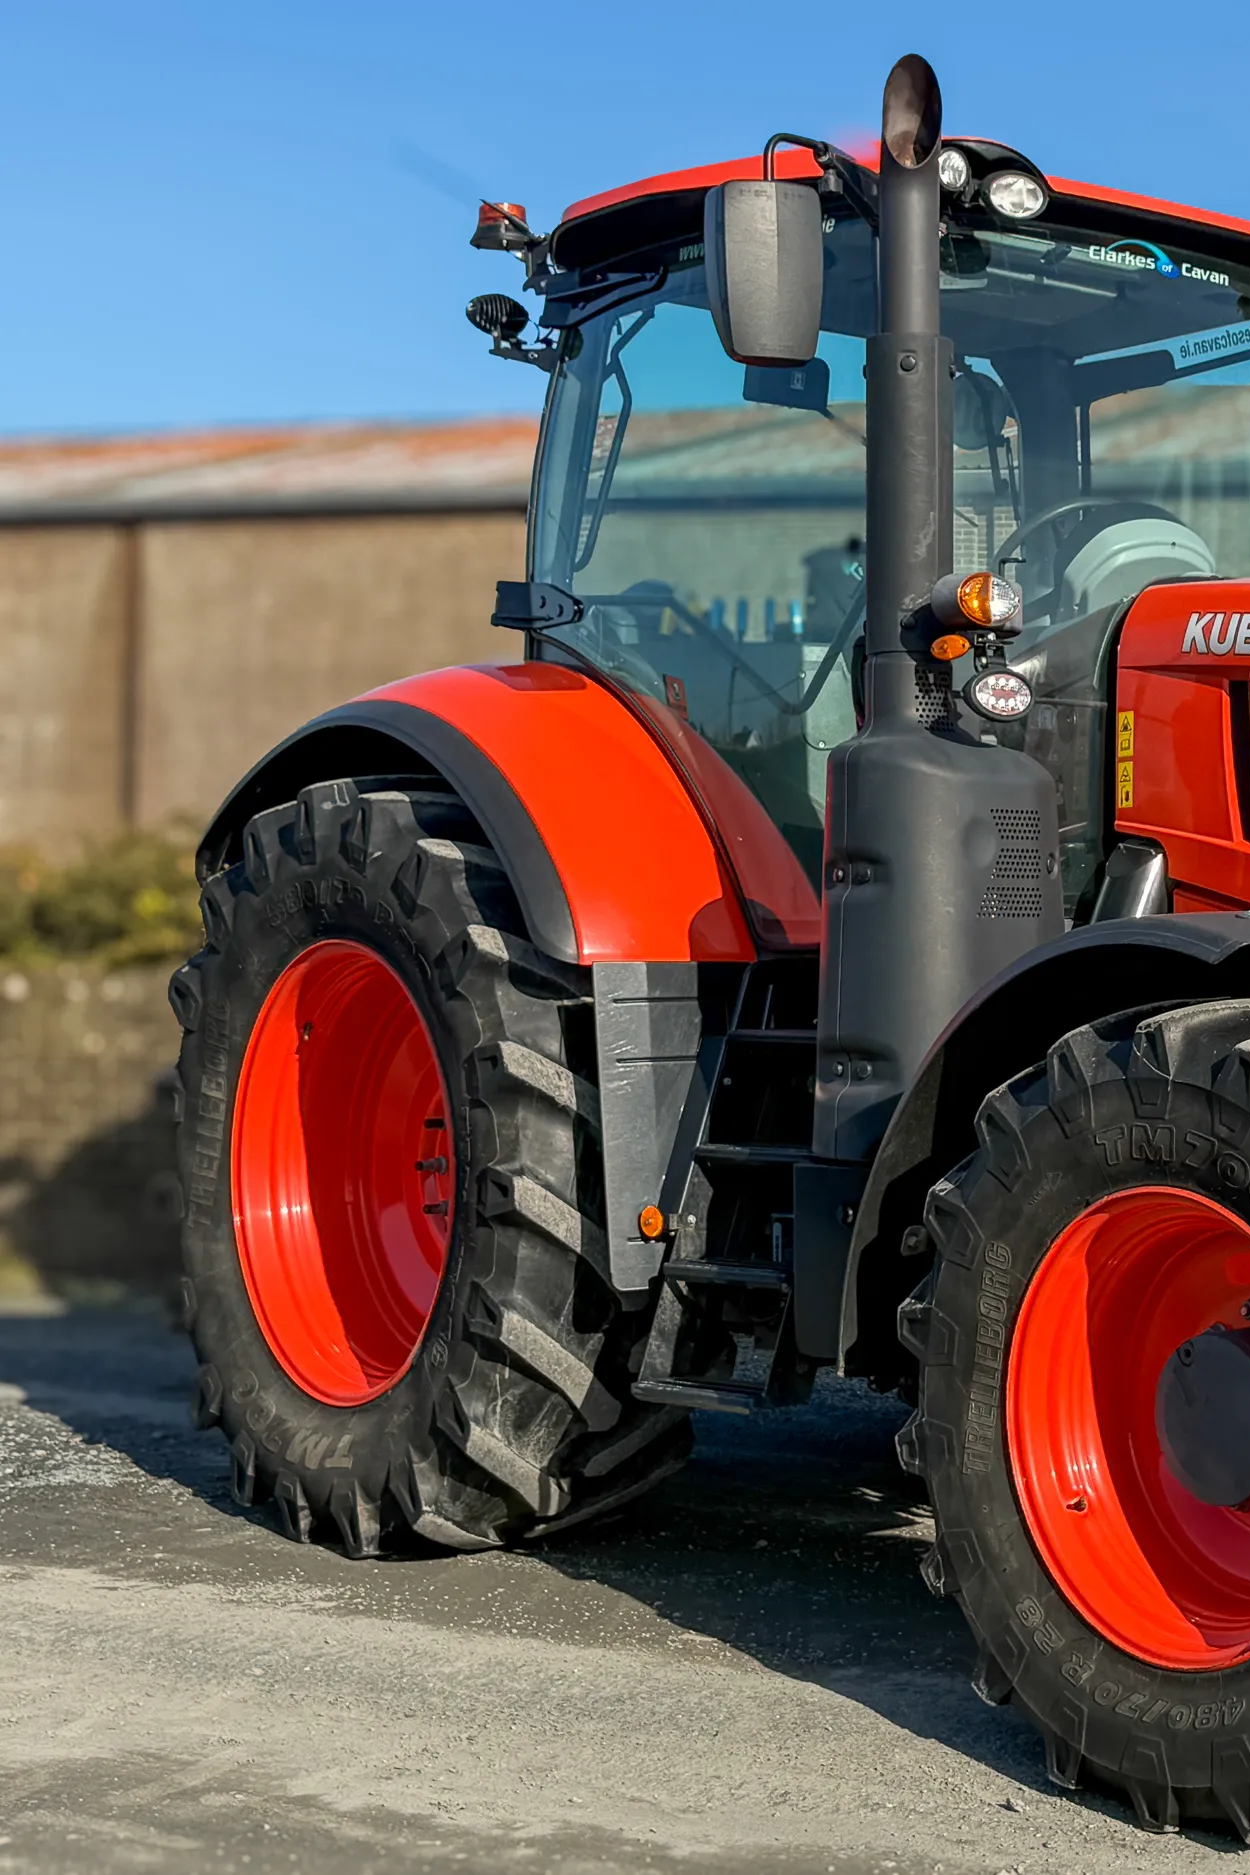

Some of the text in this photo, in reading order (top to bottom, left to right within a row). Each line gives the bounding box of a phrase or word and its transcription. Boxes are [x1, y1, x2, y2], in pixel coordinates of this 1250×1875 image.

[1088, 245, 1230, 287] Clarkes of Cavan
[187, 1000, 231, 1229] TRELLEBORG
[962, 1240, 1013, 1476] TRELLEBORG
[1014, 1595, 1247, 1731] 480/70 R 28
